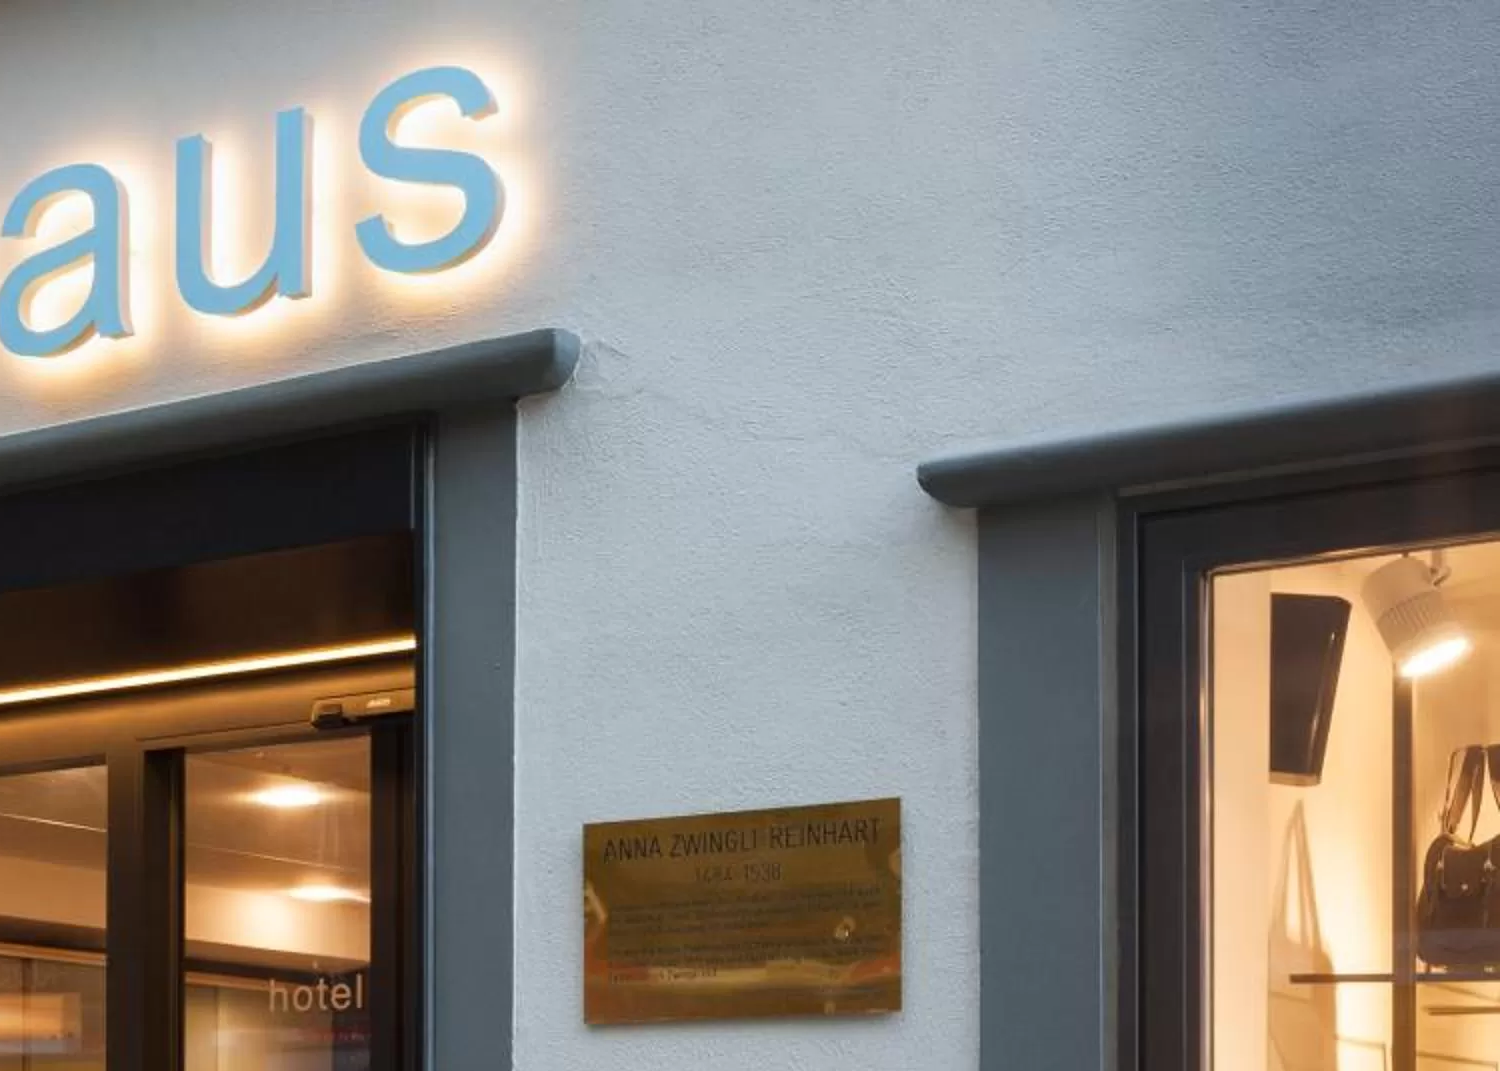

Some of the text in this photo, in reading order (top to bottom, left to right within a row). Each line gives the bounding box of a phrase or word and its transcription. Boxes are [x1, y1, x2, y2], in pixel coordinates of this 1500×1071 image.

[603, 817, 884, 863] ANNA ZWINGLI REINHART
[269, 973, 363, 1012] hotel
